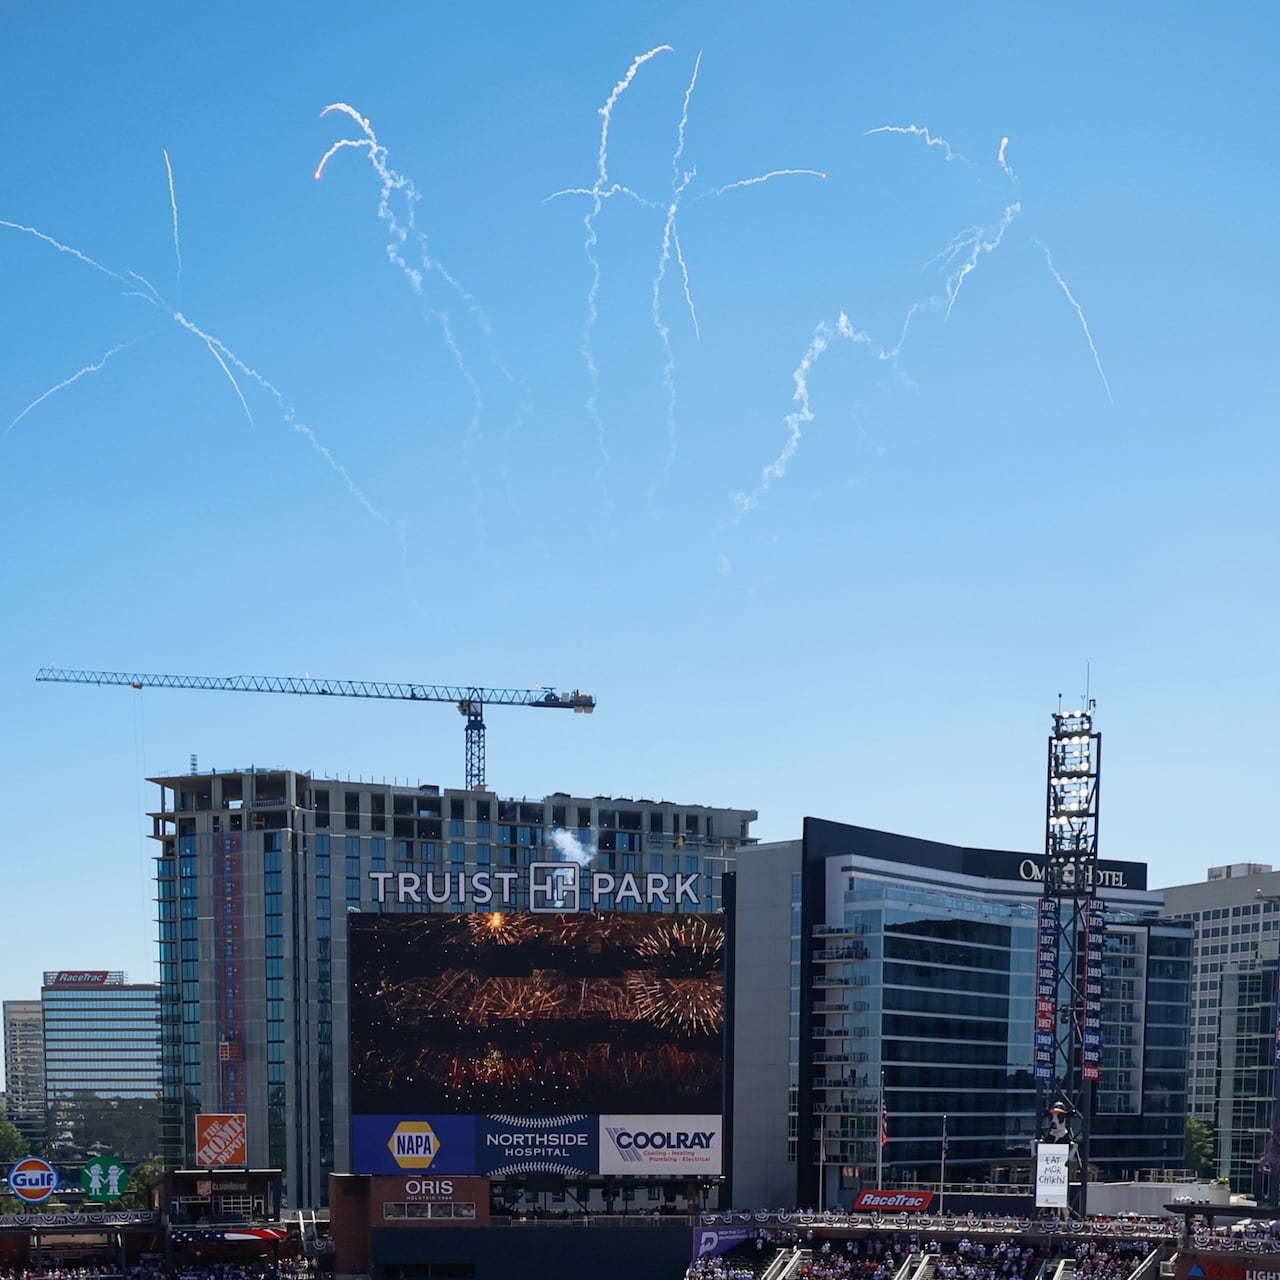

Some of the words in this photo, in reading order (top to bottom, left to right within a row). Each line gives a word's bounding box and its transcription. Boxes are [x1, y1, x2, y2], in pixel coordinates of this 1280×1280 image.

[369, 871, 519, 904] TRUIST
[592, 872, 702, 904] PARK
[59, 972, 103, 982] RaceTrac
[202, 1120, 221, 1141] THE
[198, 1115, 247, 1165] HOME
[397, 1135, 433, 1155] NAPA
[486, 1133, 589, 1146] NORTHSIDE
[616, 1132, 716, 1149] COOLRAY
[216, 1136, 246, 1164] DEPOT
[505, 1148, 570, 1157] HOSPITAL
[1045, 1156, 1061, 1164] EAT
[1044, 1165, 1061, 1174] MOR
[12, 1171, 55, 1187] Gulf
[405, 1180, 453, 1194] ORIS
[861, 1194, 923, 1206] RaceTrac
